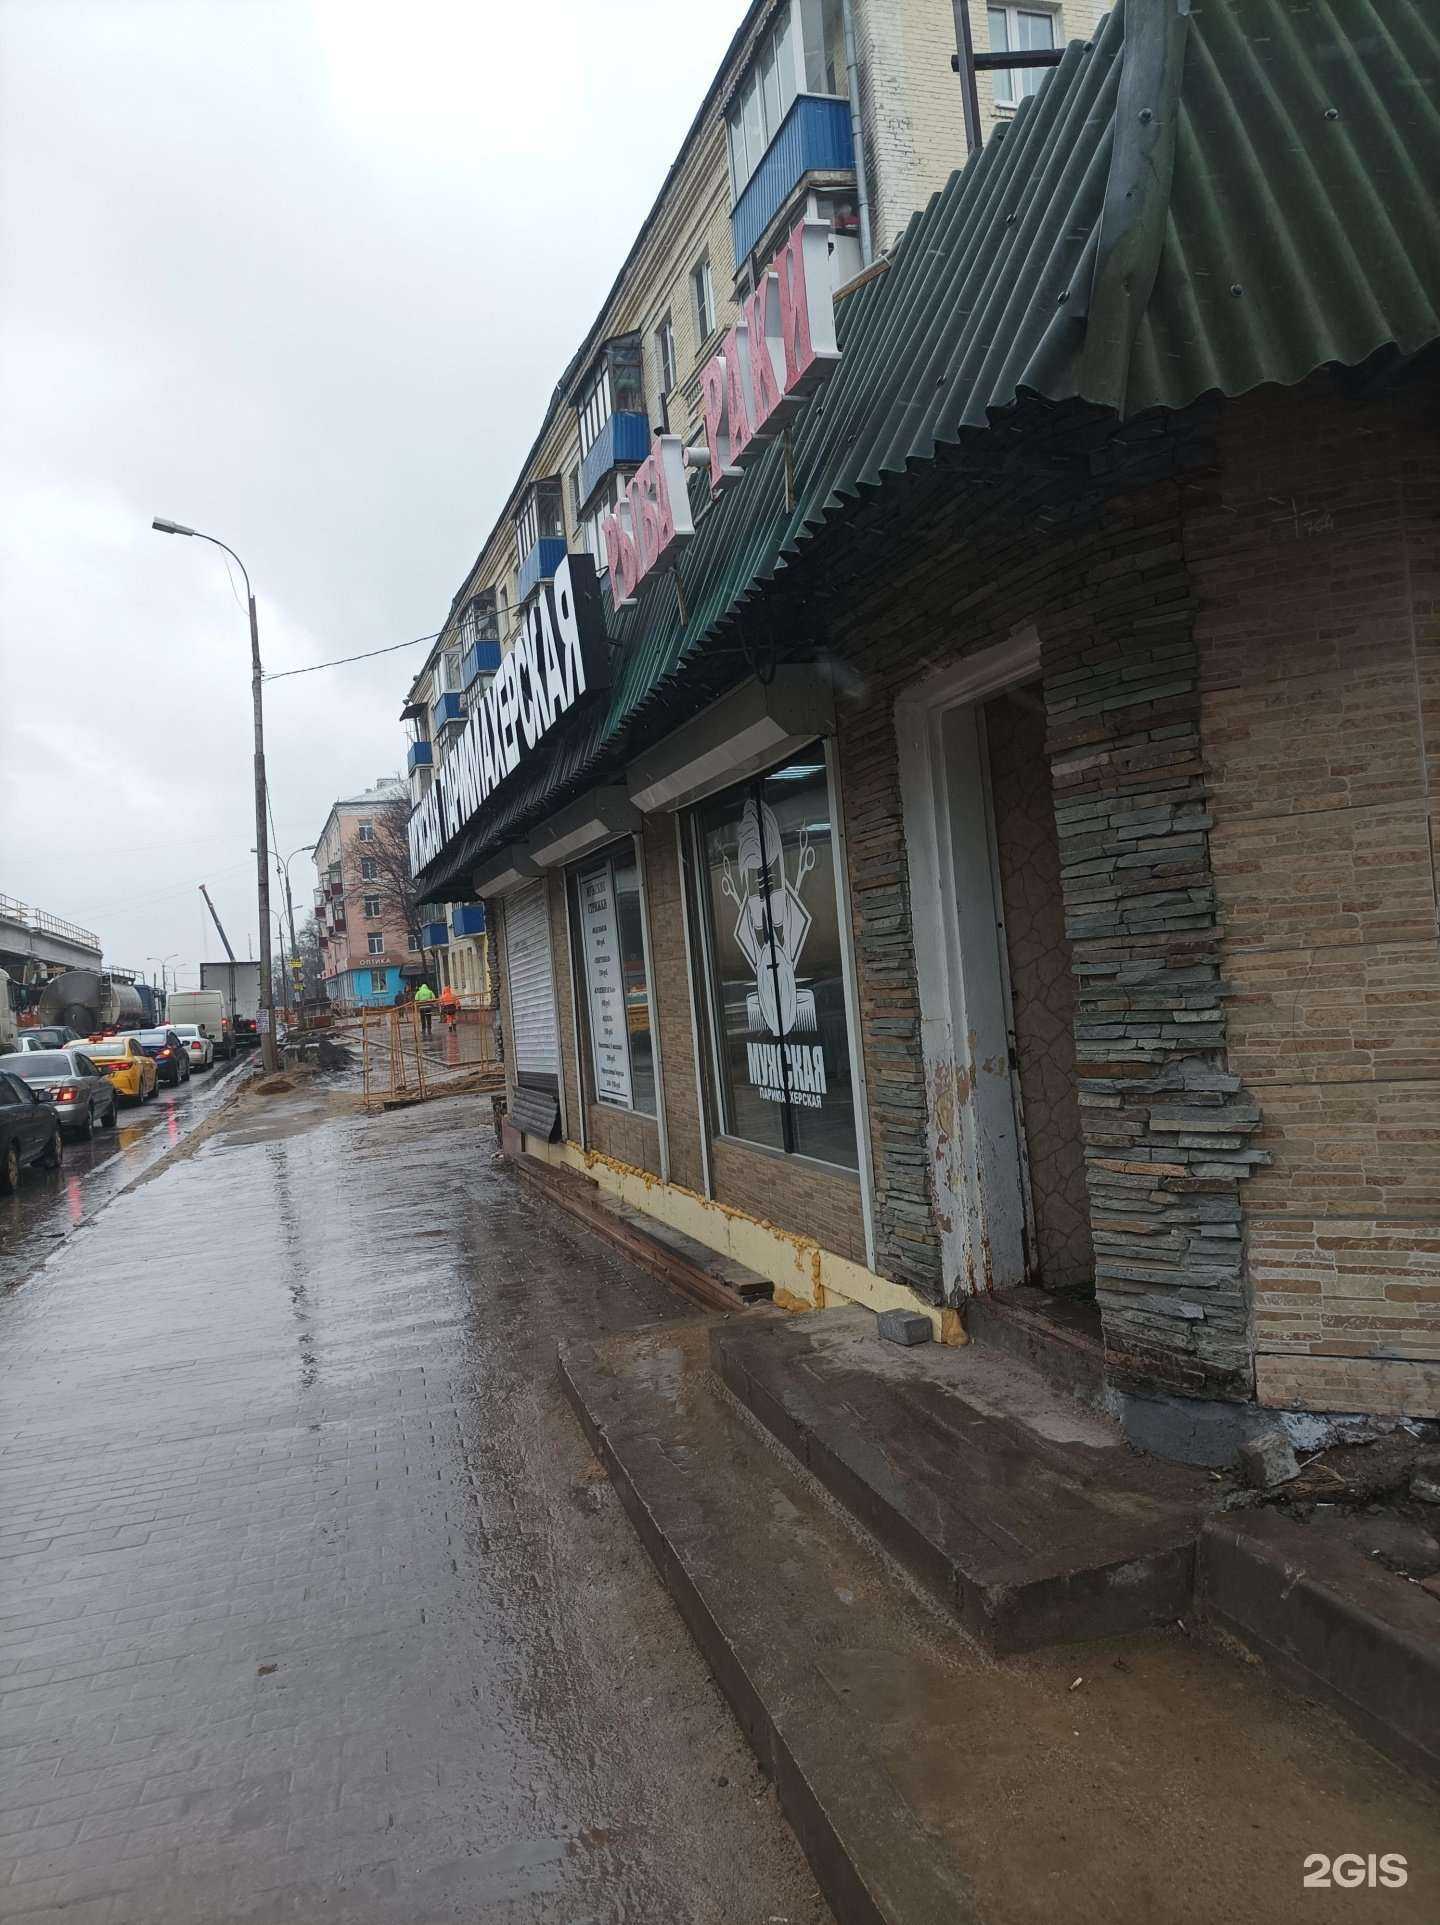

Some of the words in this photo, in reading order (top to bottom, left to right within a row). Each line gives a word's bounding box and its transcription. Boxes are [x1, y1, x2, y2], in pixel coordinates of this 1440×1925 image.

[601, 434, 678, 612] РЫБА
[700, 218, 818, 491] РАКИ
[440, 553, 586, 843] ПАРИКМАХЕРСКАЯ
[359, 958, 391, 966] ОПТИКА
[746, 1042, 827, 1094] МУЖСКАЯ
